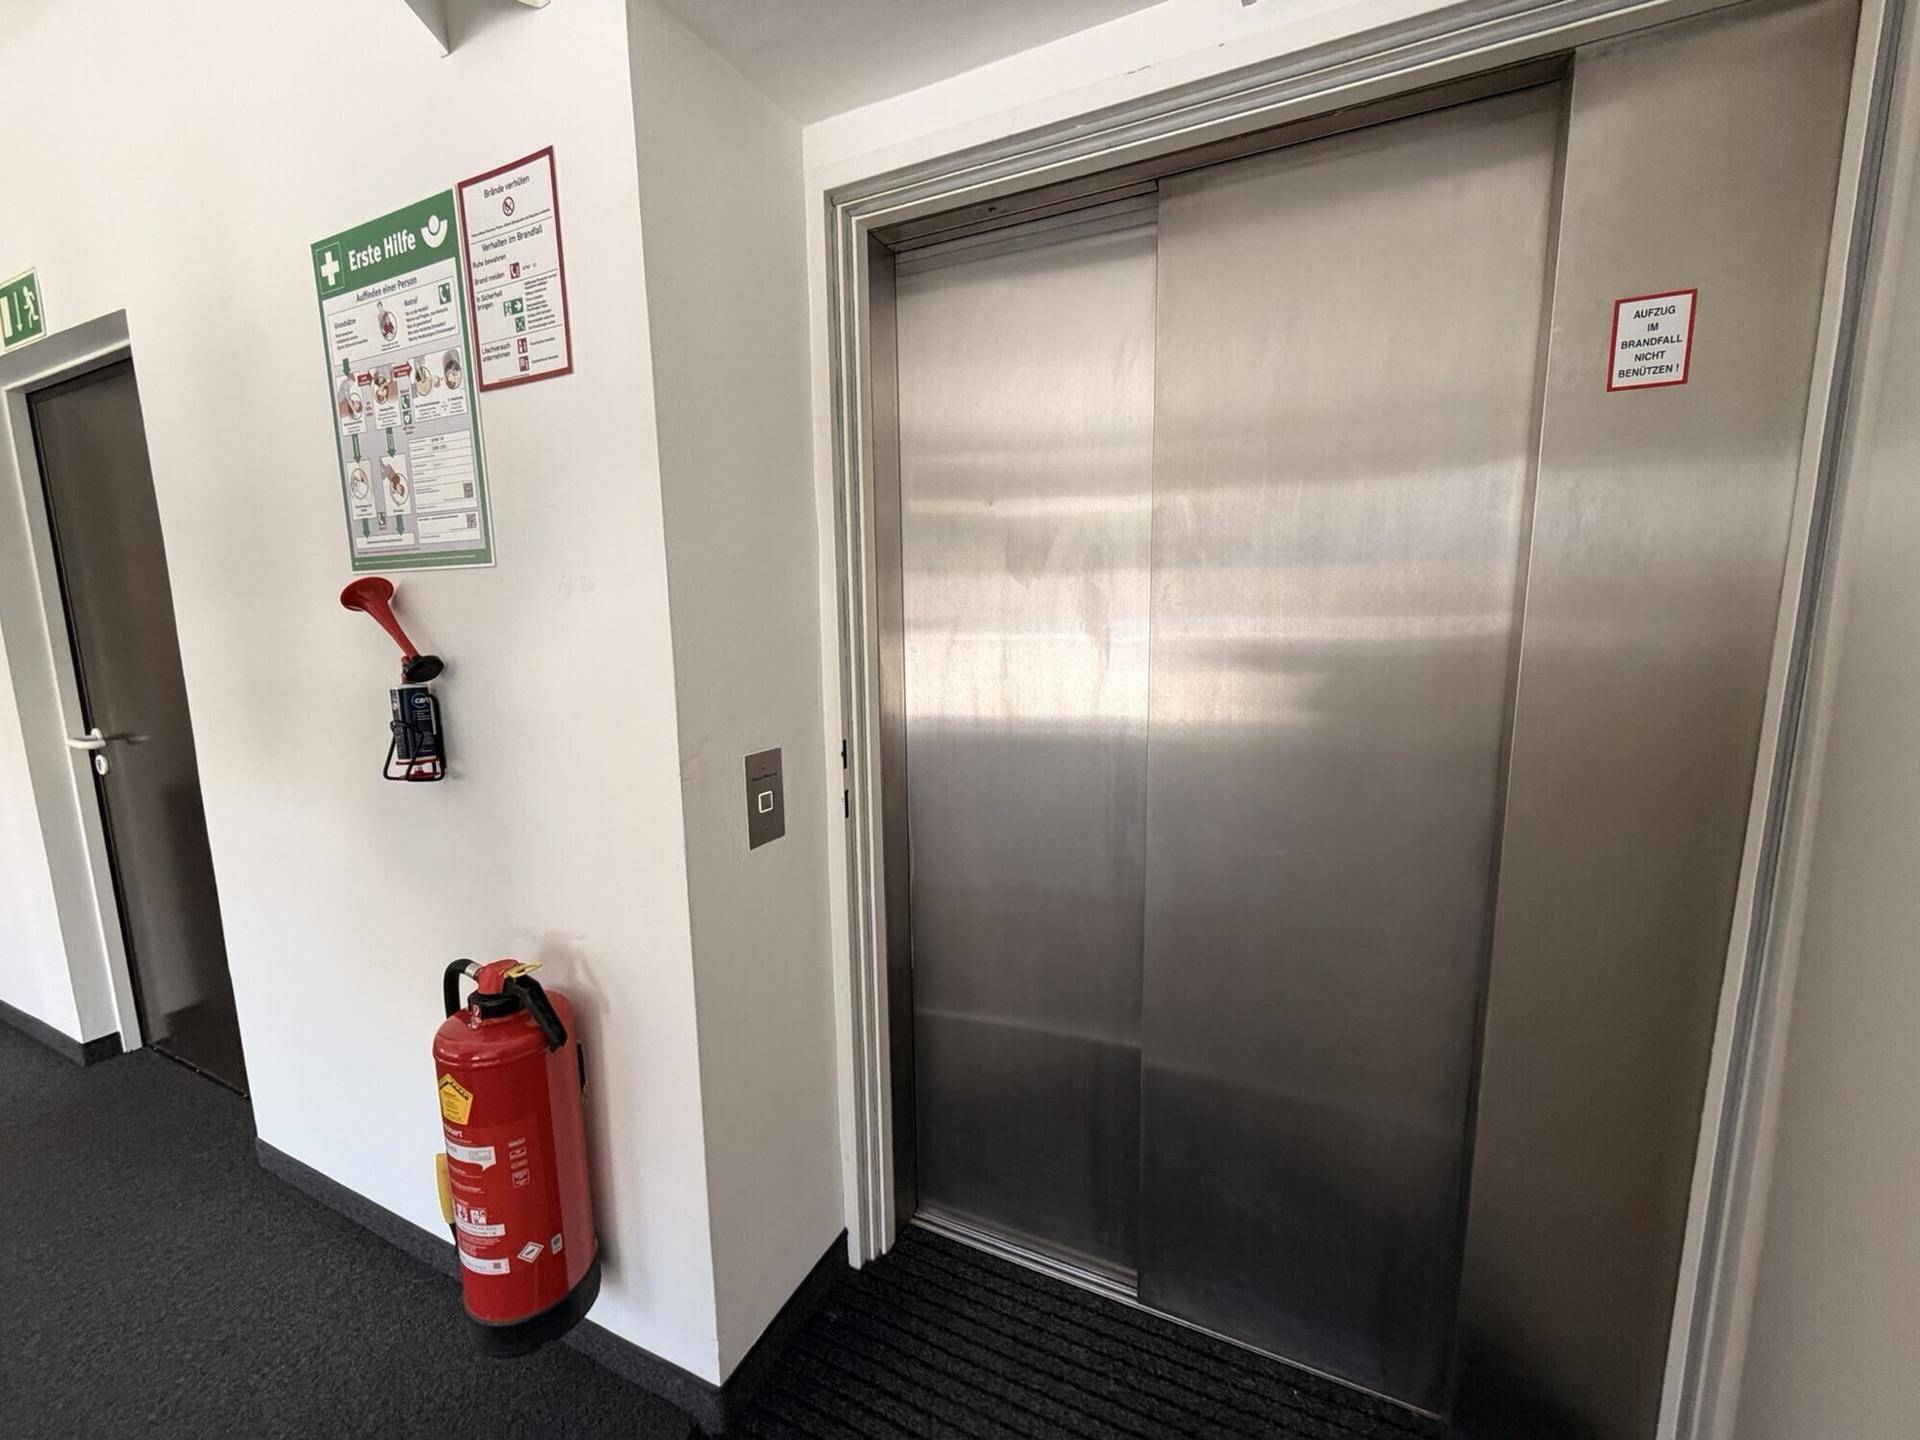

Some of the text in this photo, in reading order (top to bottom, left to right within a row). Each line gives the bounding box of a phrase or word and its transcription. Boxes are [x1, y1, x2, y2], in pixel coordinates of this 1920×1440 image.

[484, 175, 530, 198] Brände verhüten
[481, 224, 543, 252] Verhalten im Brandfall
[348, 229, 416, 271] Erste Hilfe
[397, 277, 418, 290] Person
[1633, 305, 1676, 319] AUFZUG
[1647, 322, 1659, 332] IM
[1620, 334, 1683, 350] BRANDFALL
[1634, 350, 1666, 362] NICHT
[1617, 364, 1673, 378] BENÜTZEN
